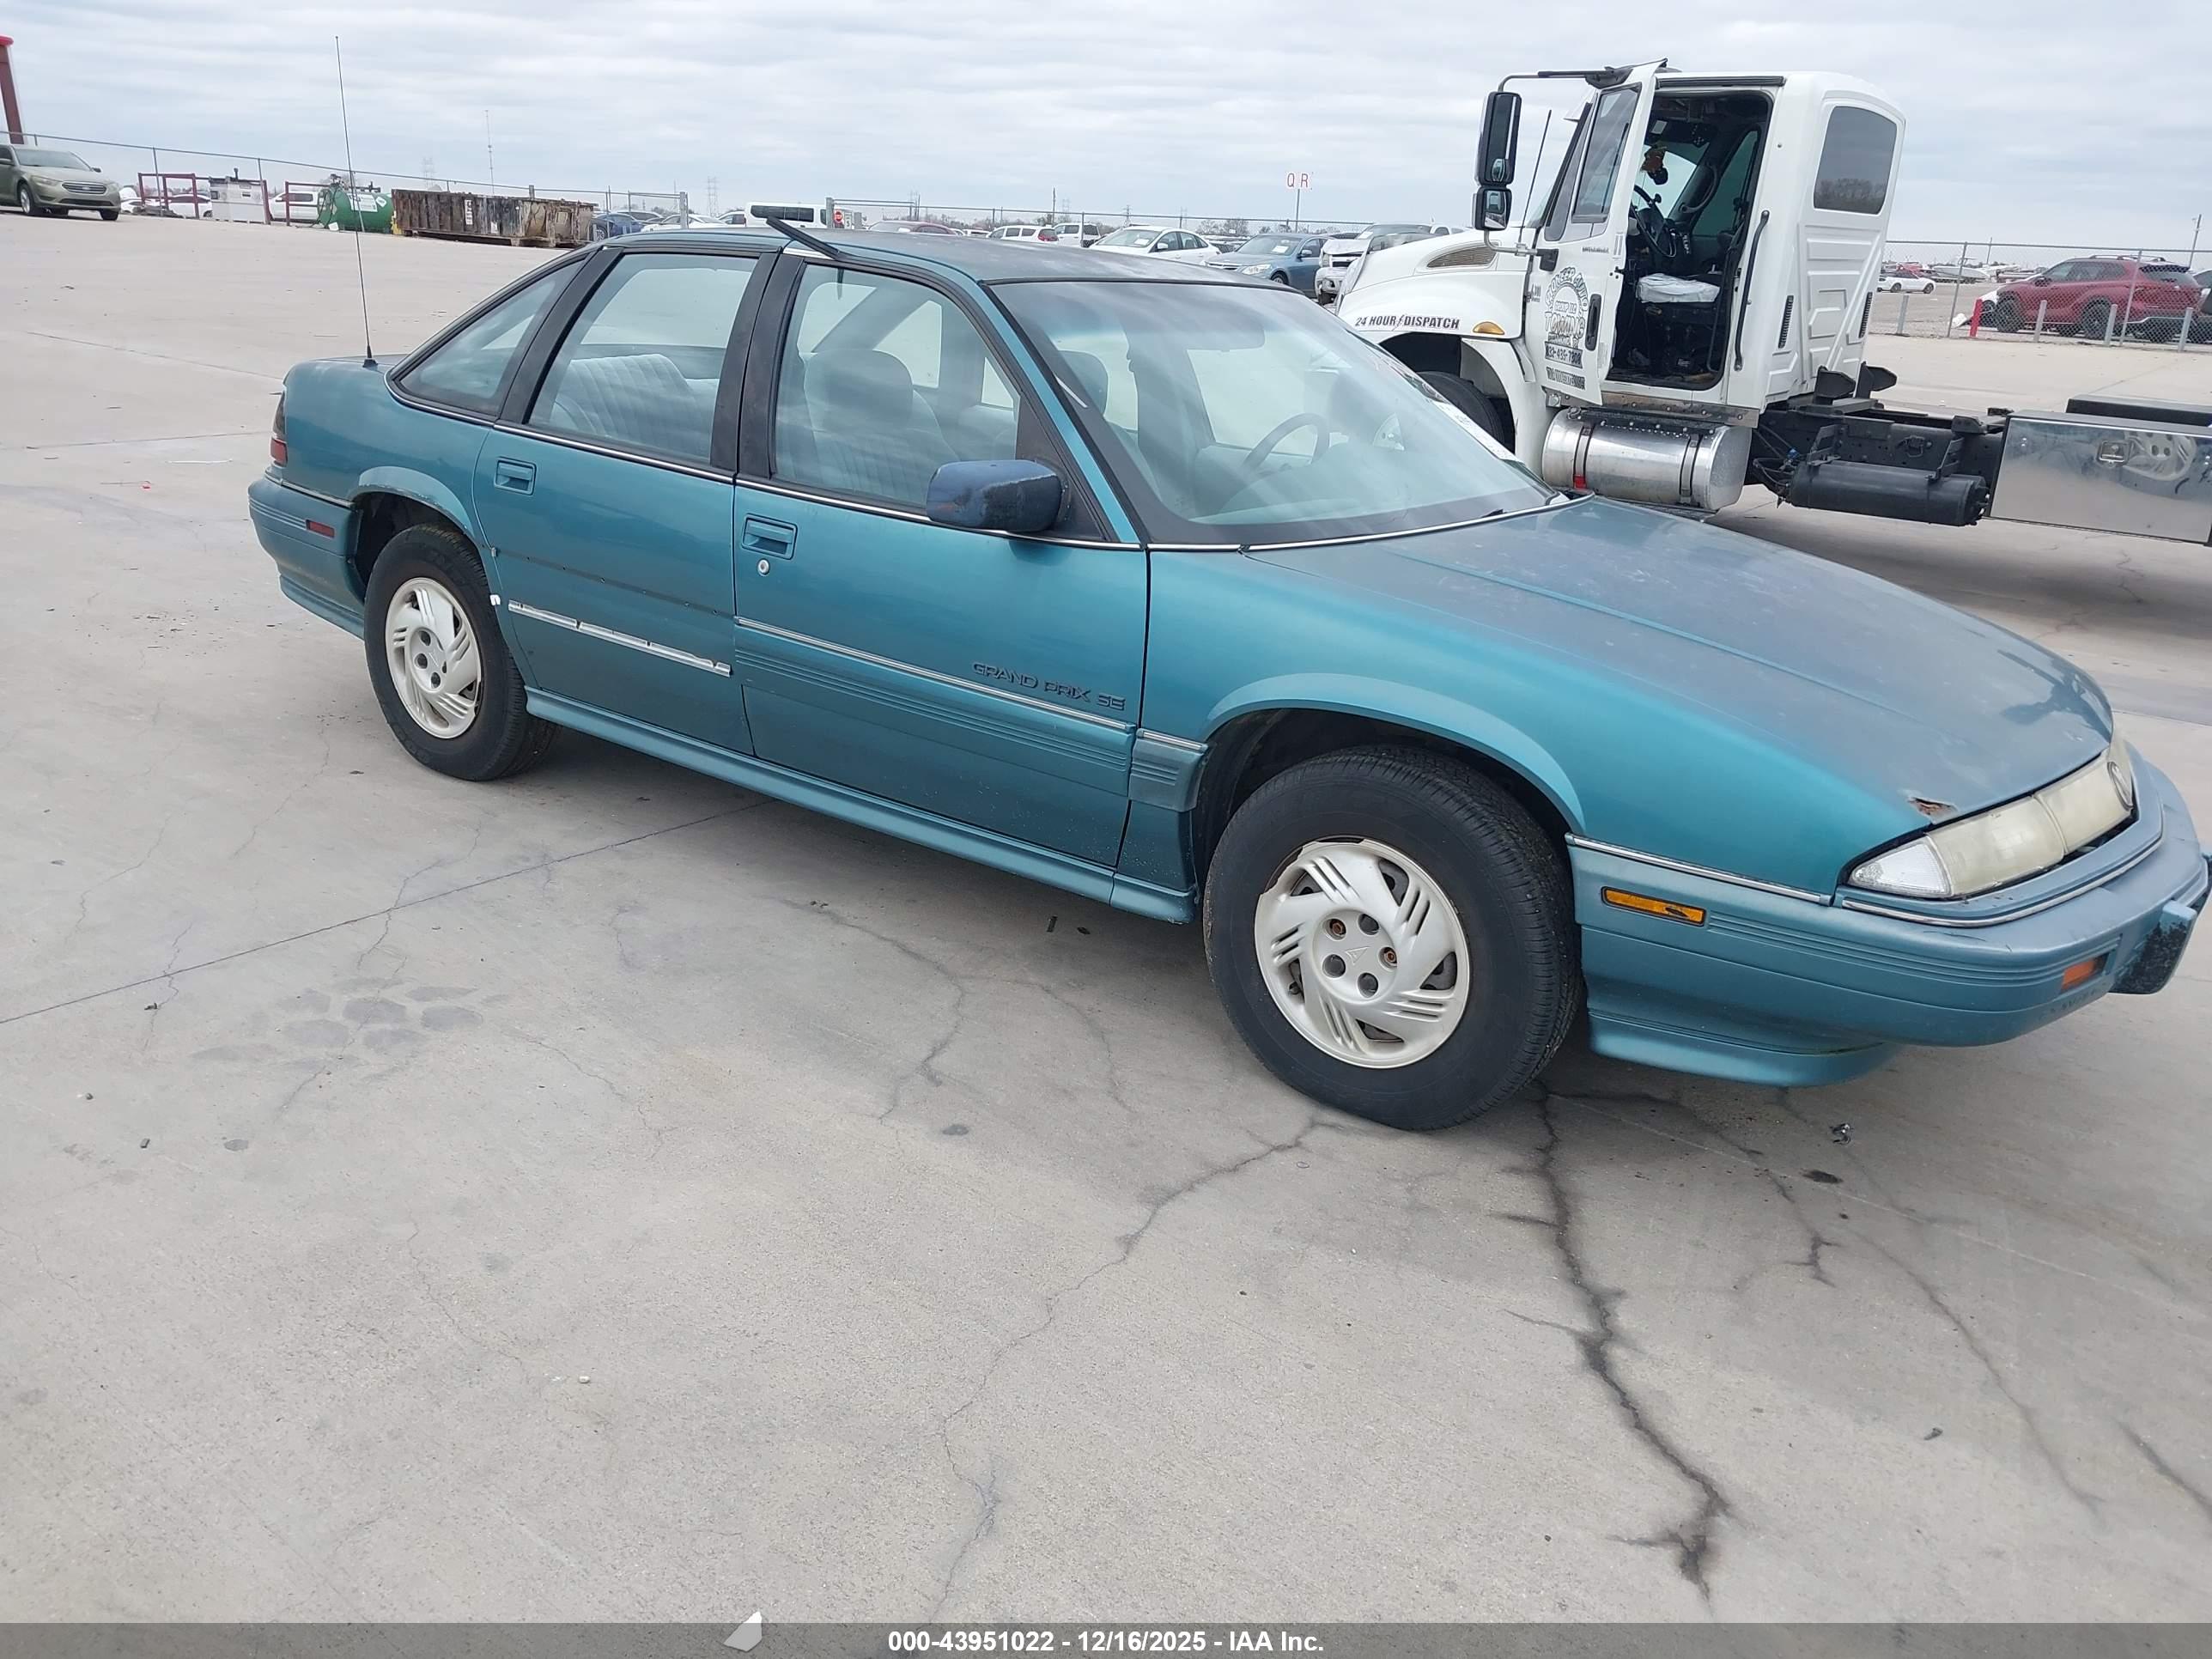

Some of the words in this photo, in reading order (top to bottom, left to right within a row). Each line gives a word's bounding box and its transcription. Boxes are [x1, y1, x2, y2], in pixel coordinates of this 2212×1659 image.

[1287, 173, 1295, 187] Q
[1300, 173, 1309, 188] R
[1545, 266, 1577, 307] PIONEER
[1573, 272, 1589, 312] AUTO
[1355, 316, 1368, 326] 24
[1369, 315, 1397, 326] HOUR
[1403, 316, 1460, 329] DISPATCH
[1544, 311, 1586, 339] TOWING
[973, 662, 1038, 689] GRAND
[1044, 682, 1091, 702] PRIX
[1098, 694, 1126, 711] SE
